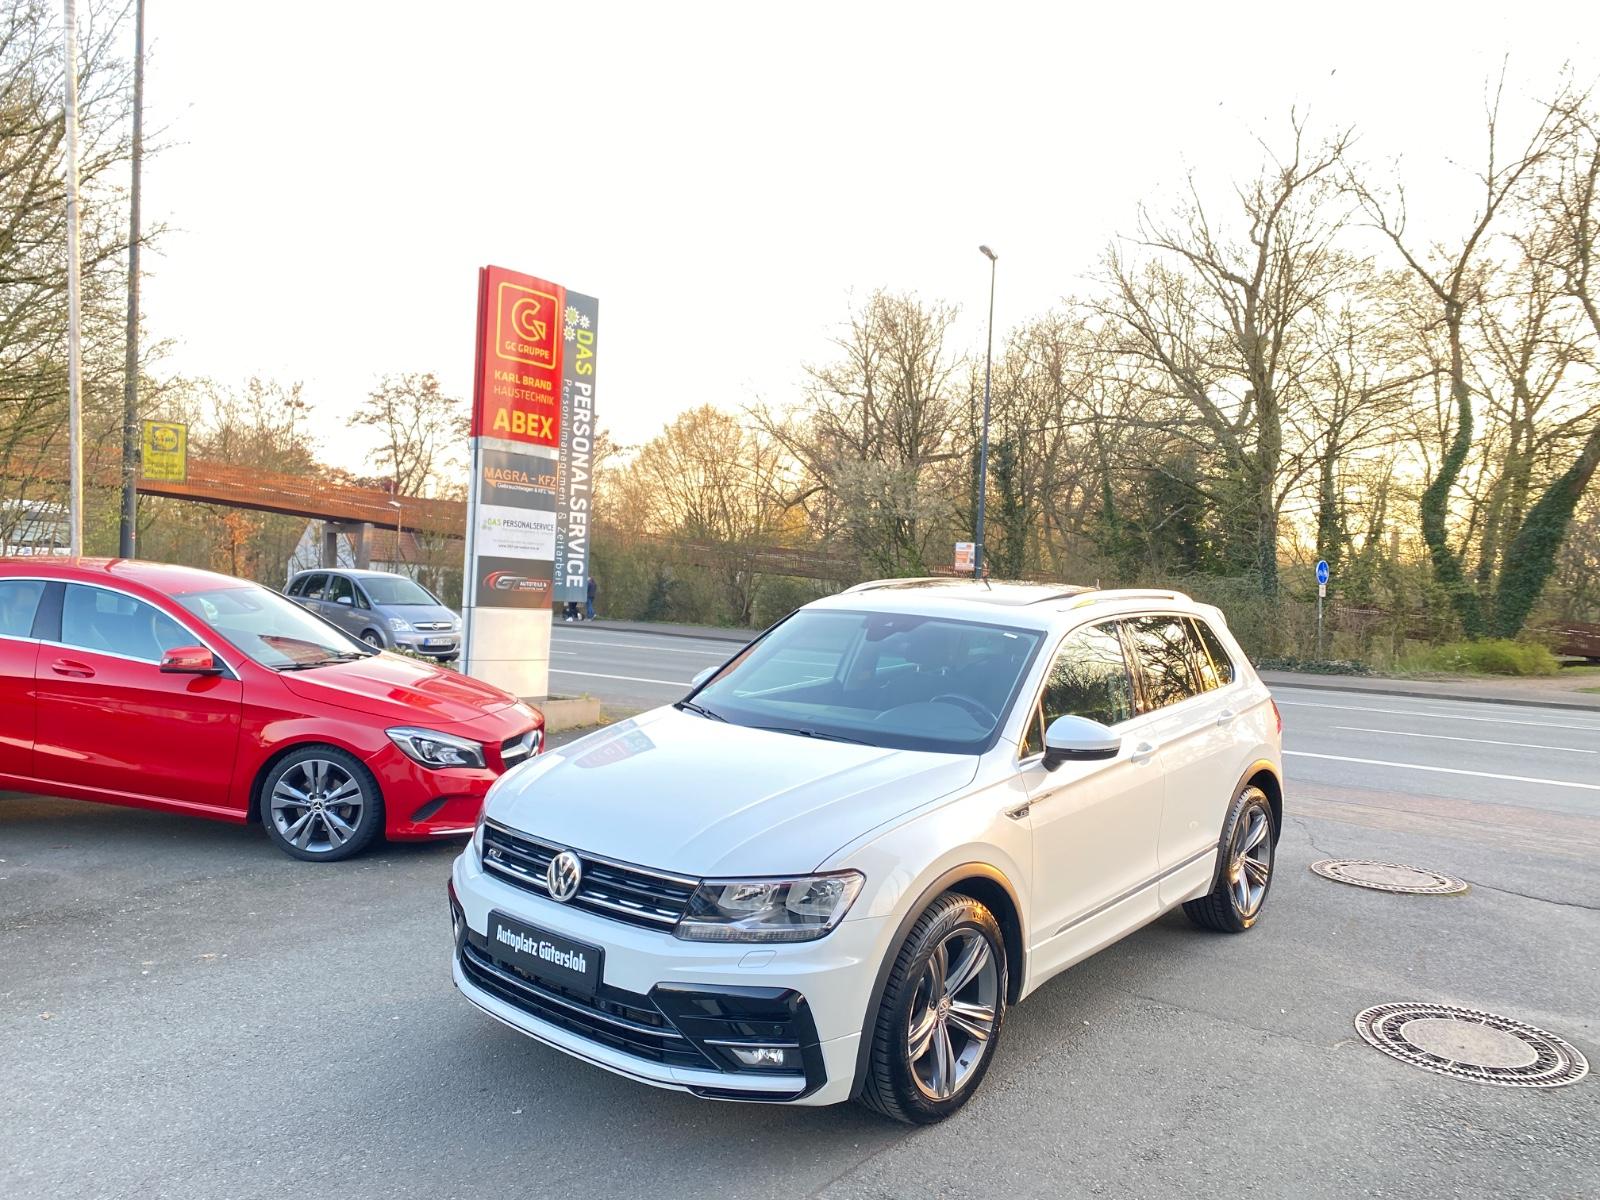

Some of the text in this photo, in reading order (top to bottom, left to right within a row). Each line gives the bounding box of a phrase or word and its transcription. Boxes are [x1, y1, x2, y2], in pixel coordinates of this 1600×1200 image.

[505, 341, 550, 359] GC GRUPPE
[494, 370, 552, 391] KARL BRAND
[494, 385, 555, 405] HAUSTECHNIK
[493, 407, 553, 440] ABEX
[566, 328, 593, 588] DAS PERSONALSERVICE
[484, 466, 529, 483] MAGRA
[538, 474, 556, 487] KFZ
[502, 519, 555, 532] PERSONALSERVICE
[554, 526, 567, 586] Zeitarbeit
[496, 924, 586, 974] Autoplatz Gütersloh
